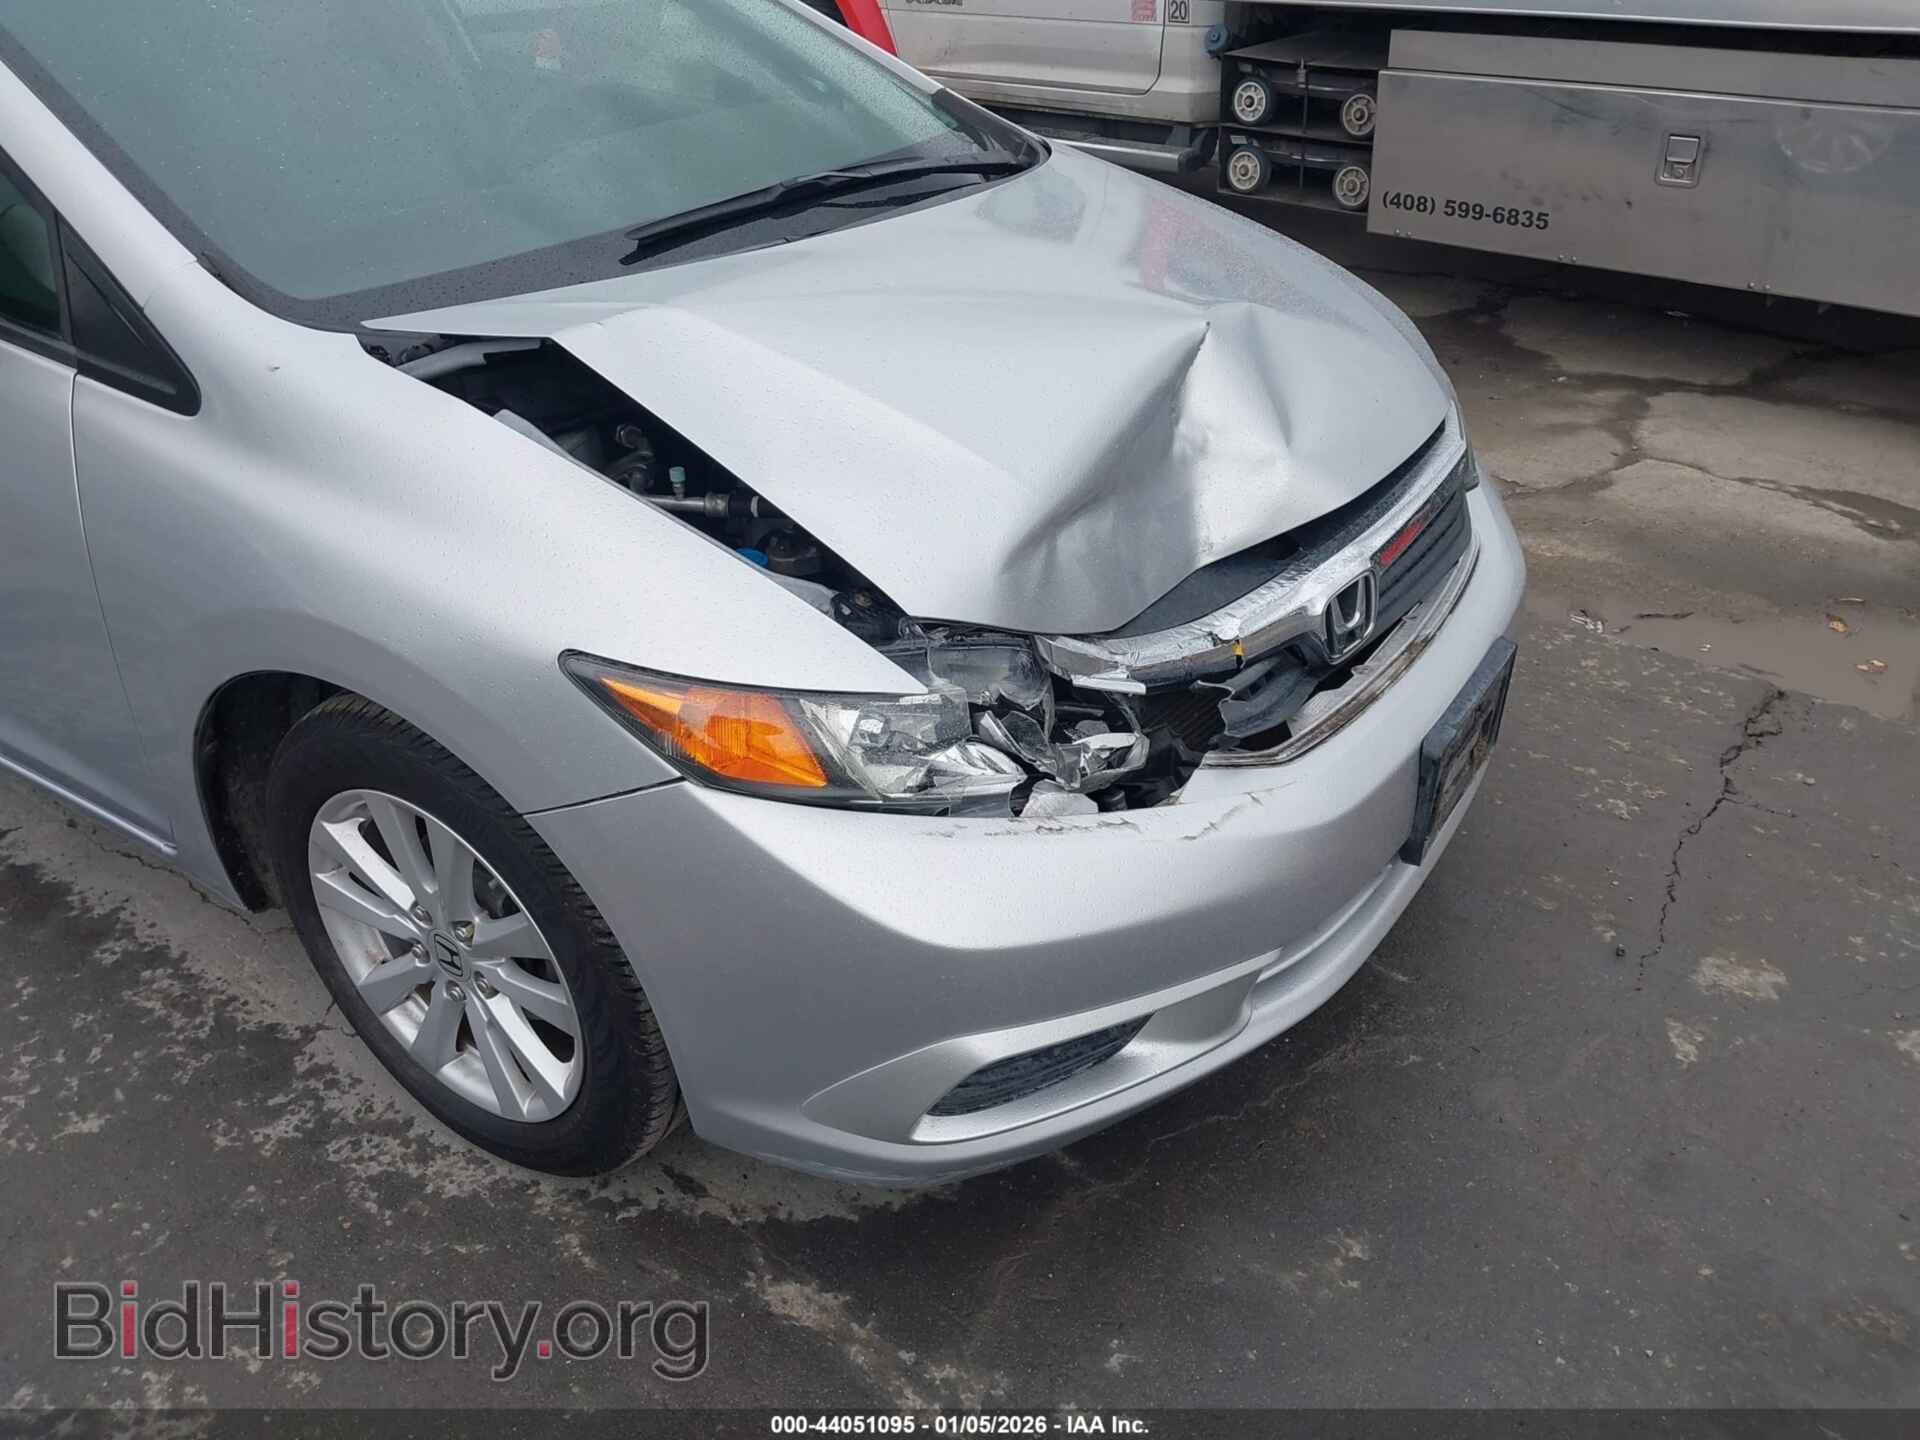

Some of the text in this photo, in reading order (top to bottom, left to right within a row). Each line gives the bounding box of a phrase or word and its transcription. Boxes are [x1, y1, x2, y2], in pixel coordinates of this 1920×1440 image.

[1170, 0, 1188, 20] 20
[1382, 190, 1550, 230] (408) 599-6835
